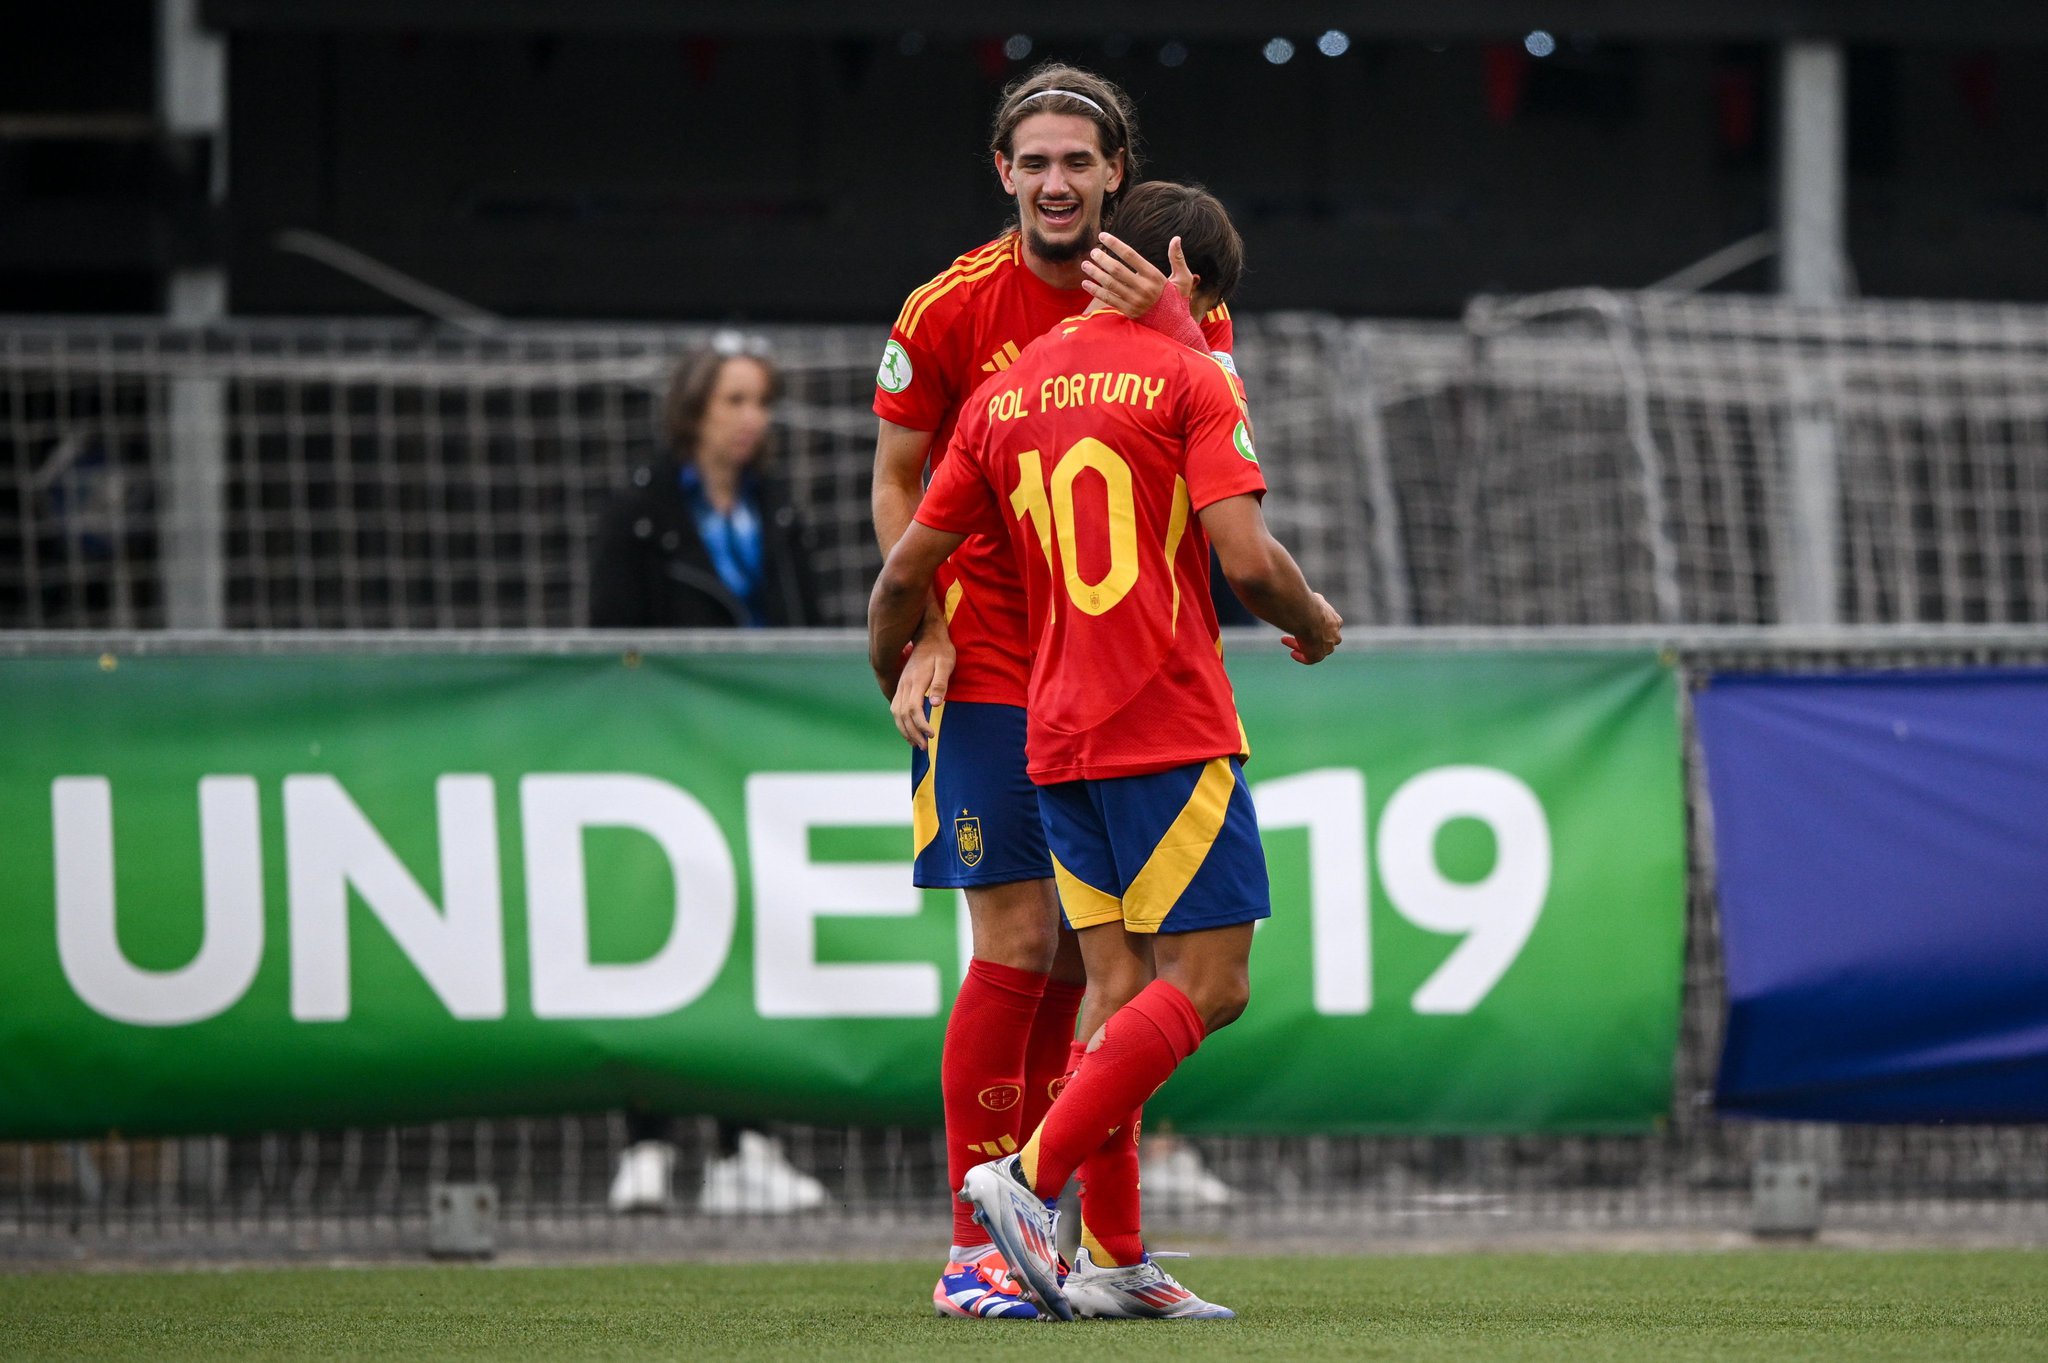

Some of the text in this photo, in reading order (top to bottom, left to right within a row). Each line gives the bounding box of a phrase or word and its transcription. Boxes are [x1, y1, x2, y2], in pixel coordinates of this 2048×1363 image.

[989, 372, 1166, 424] POL FORTUNY
[1009, 436, 1140, 625] 10
[51, 770, 974, 1027] UNDE
